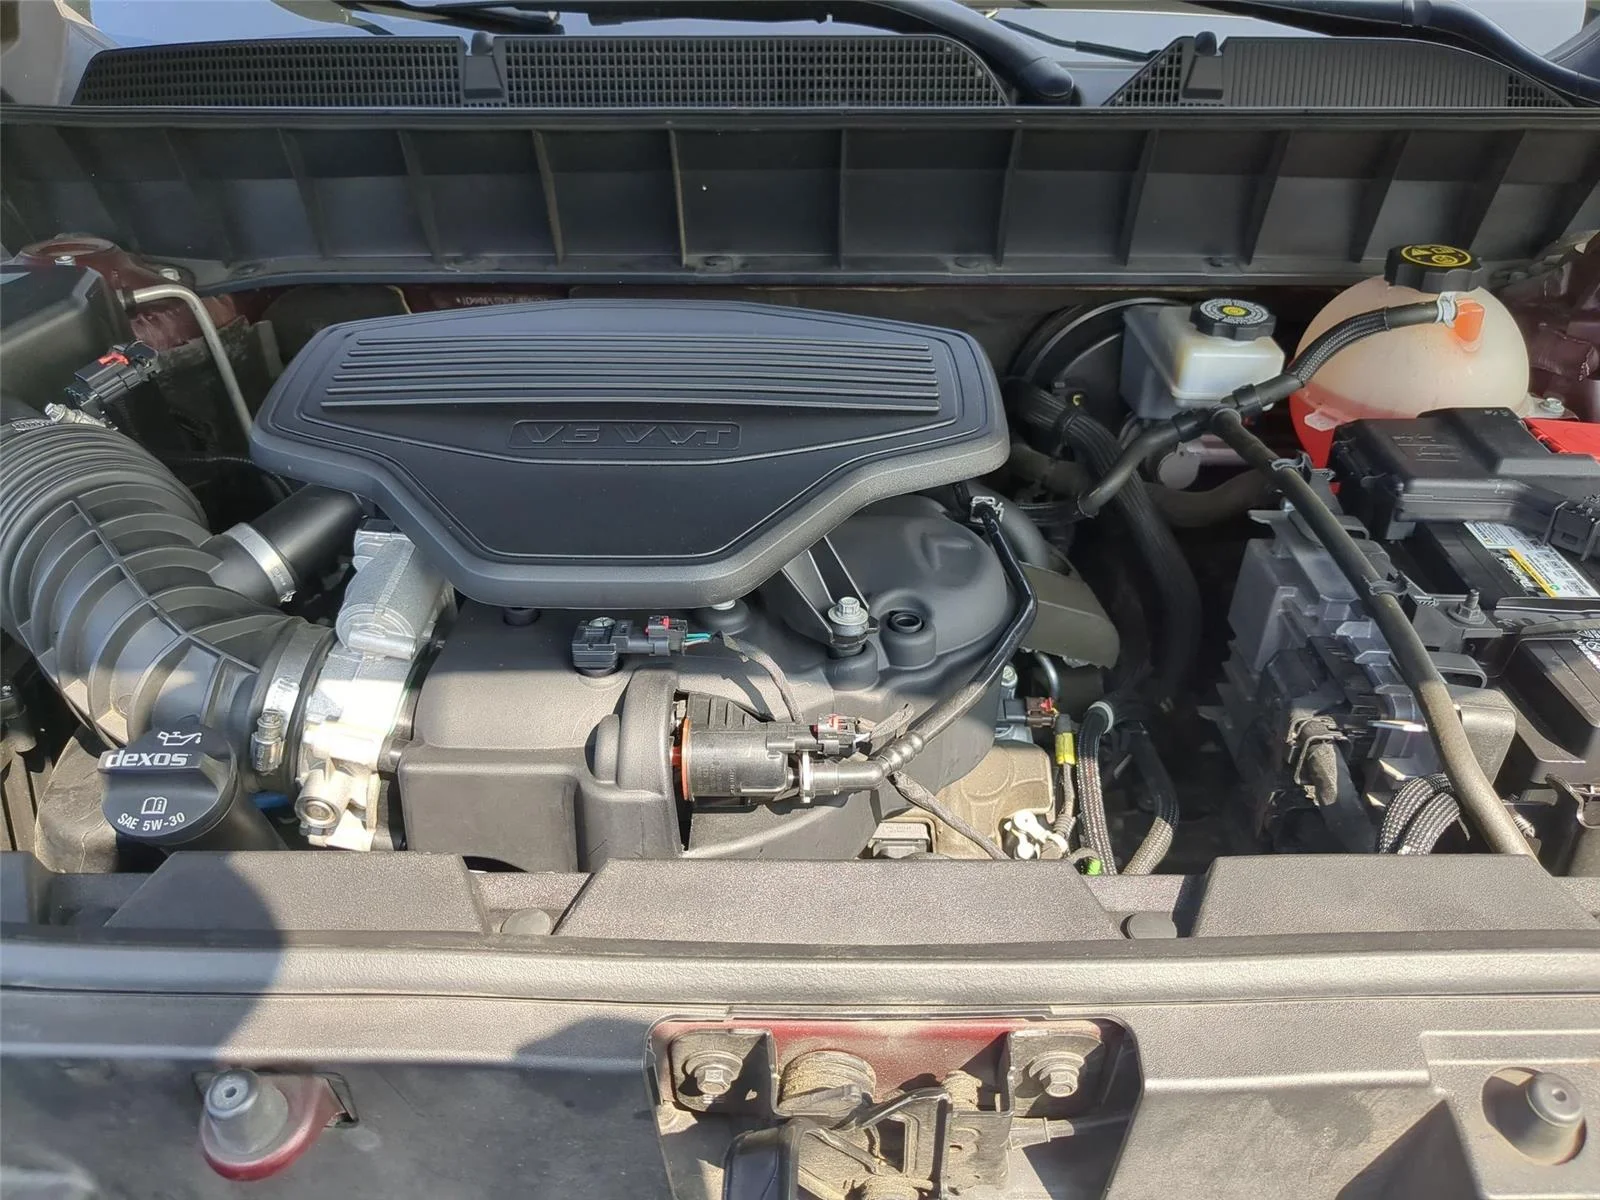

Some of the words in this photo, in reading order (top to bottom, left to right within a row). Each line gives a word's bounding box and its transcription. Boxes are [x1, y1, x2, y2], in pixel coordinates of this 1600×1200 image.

[521, 424, 600, 443] V6
[614, 424, 732, 445] VVT
[105, 750, 190, 768] dexos
[117, 812, 140, 830] SAE
[143, 812, 186, 831] 5W-30
